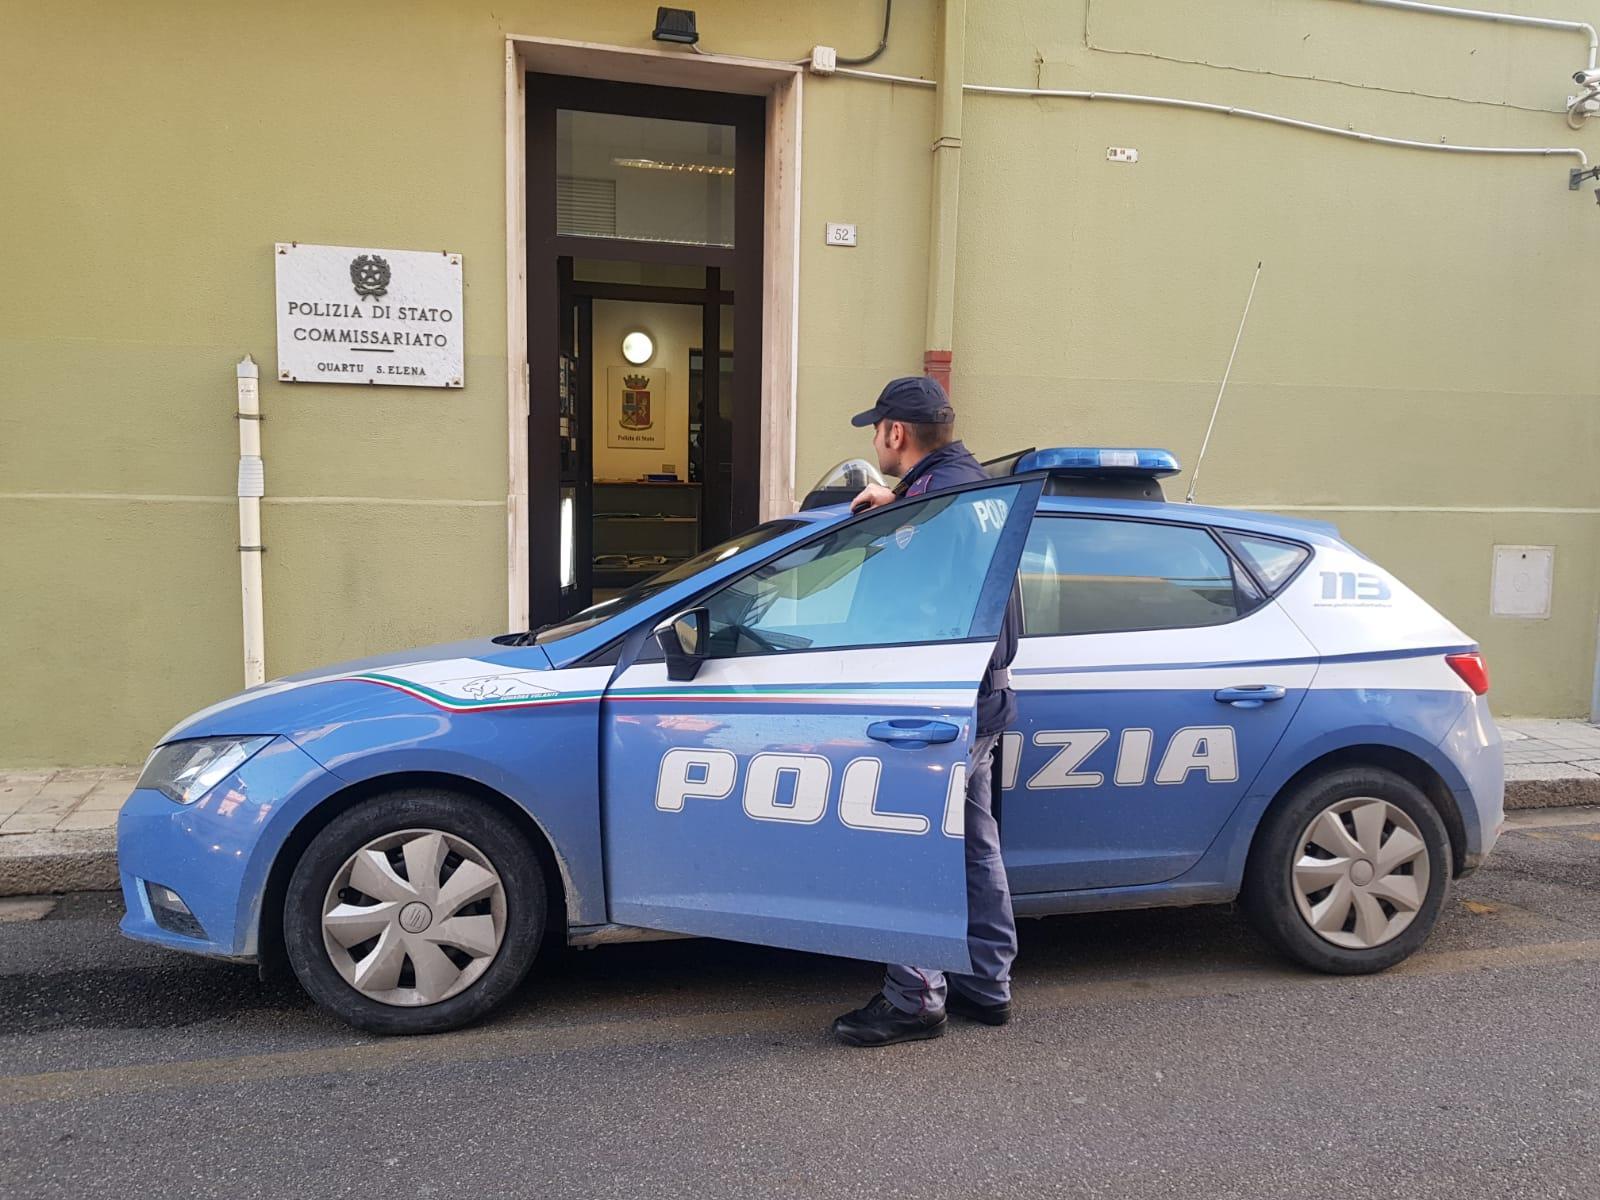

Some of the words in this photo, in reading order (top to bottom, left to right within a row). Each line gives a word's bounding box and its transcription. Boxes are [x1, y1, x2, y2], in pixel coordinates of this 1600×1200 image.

[834, 228, 849, 241] 52
[288, 302, 363, 319] POLIZIA
[372, 305, 391, 319] DI
[398, 307, 453, 323] STATO
[293, 328, 448, 348] COMMISSARIATO
[317, 362, 364, 373] QUARTU
[1319, 571, 1392, 600] 113
